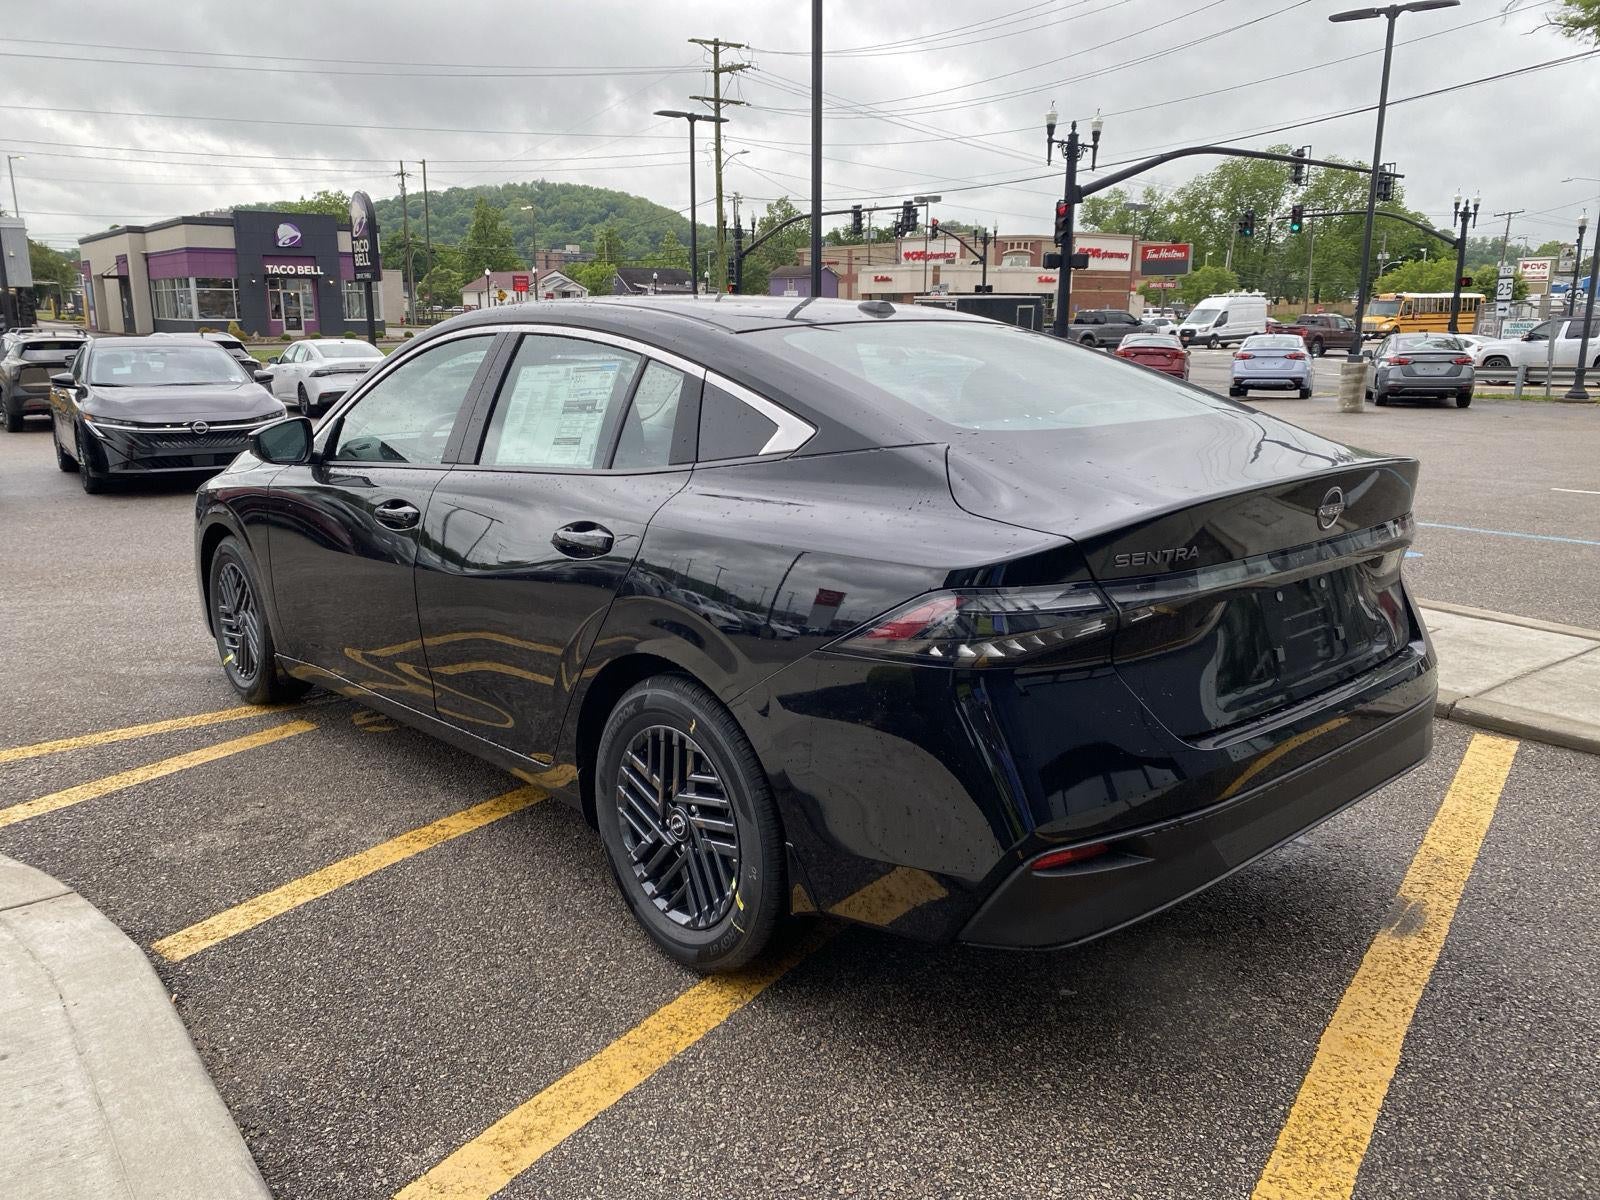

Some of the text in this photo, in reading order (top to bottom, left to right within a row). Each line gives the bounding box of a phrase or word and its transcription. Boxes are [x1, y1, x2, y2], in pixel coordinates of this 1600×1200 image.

[353, 239, 369, 253] TACO
[355, 253, 371, 267] BELL
[1146, 248, 1185, 259] Tim Hortons
[265, 264, 324, 275] TACO BELL
[1530, 262, 1548, 270] CVS
[1498, 282, 1513, 296] 25
[1114, 545, 1200, 568] SENTRA
